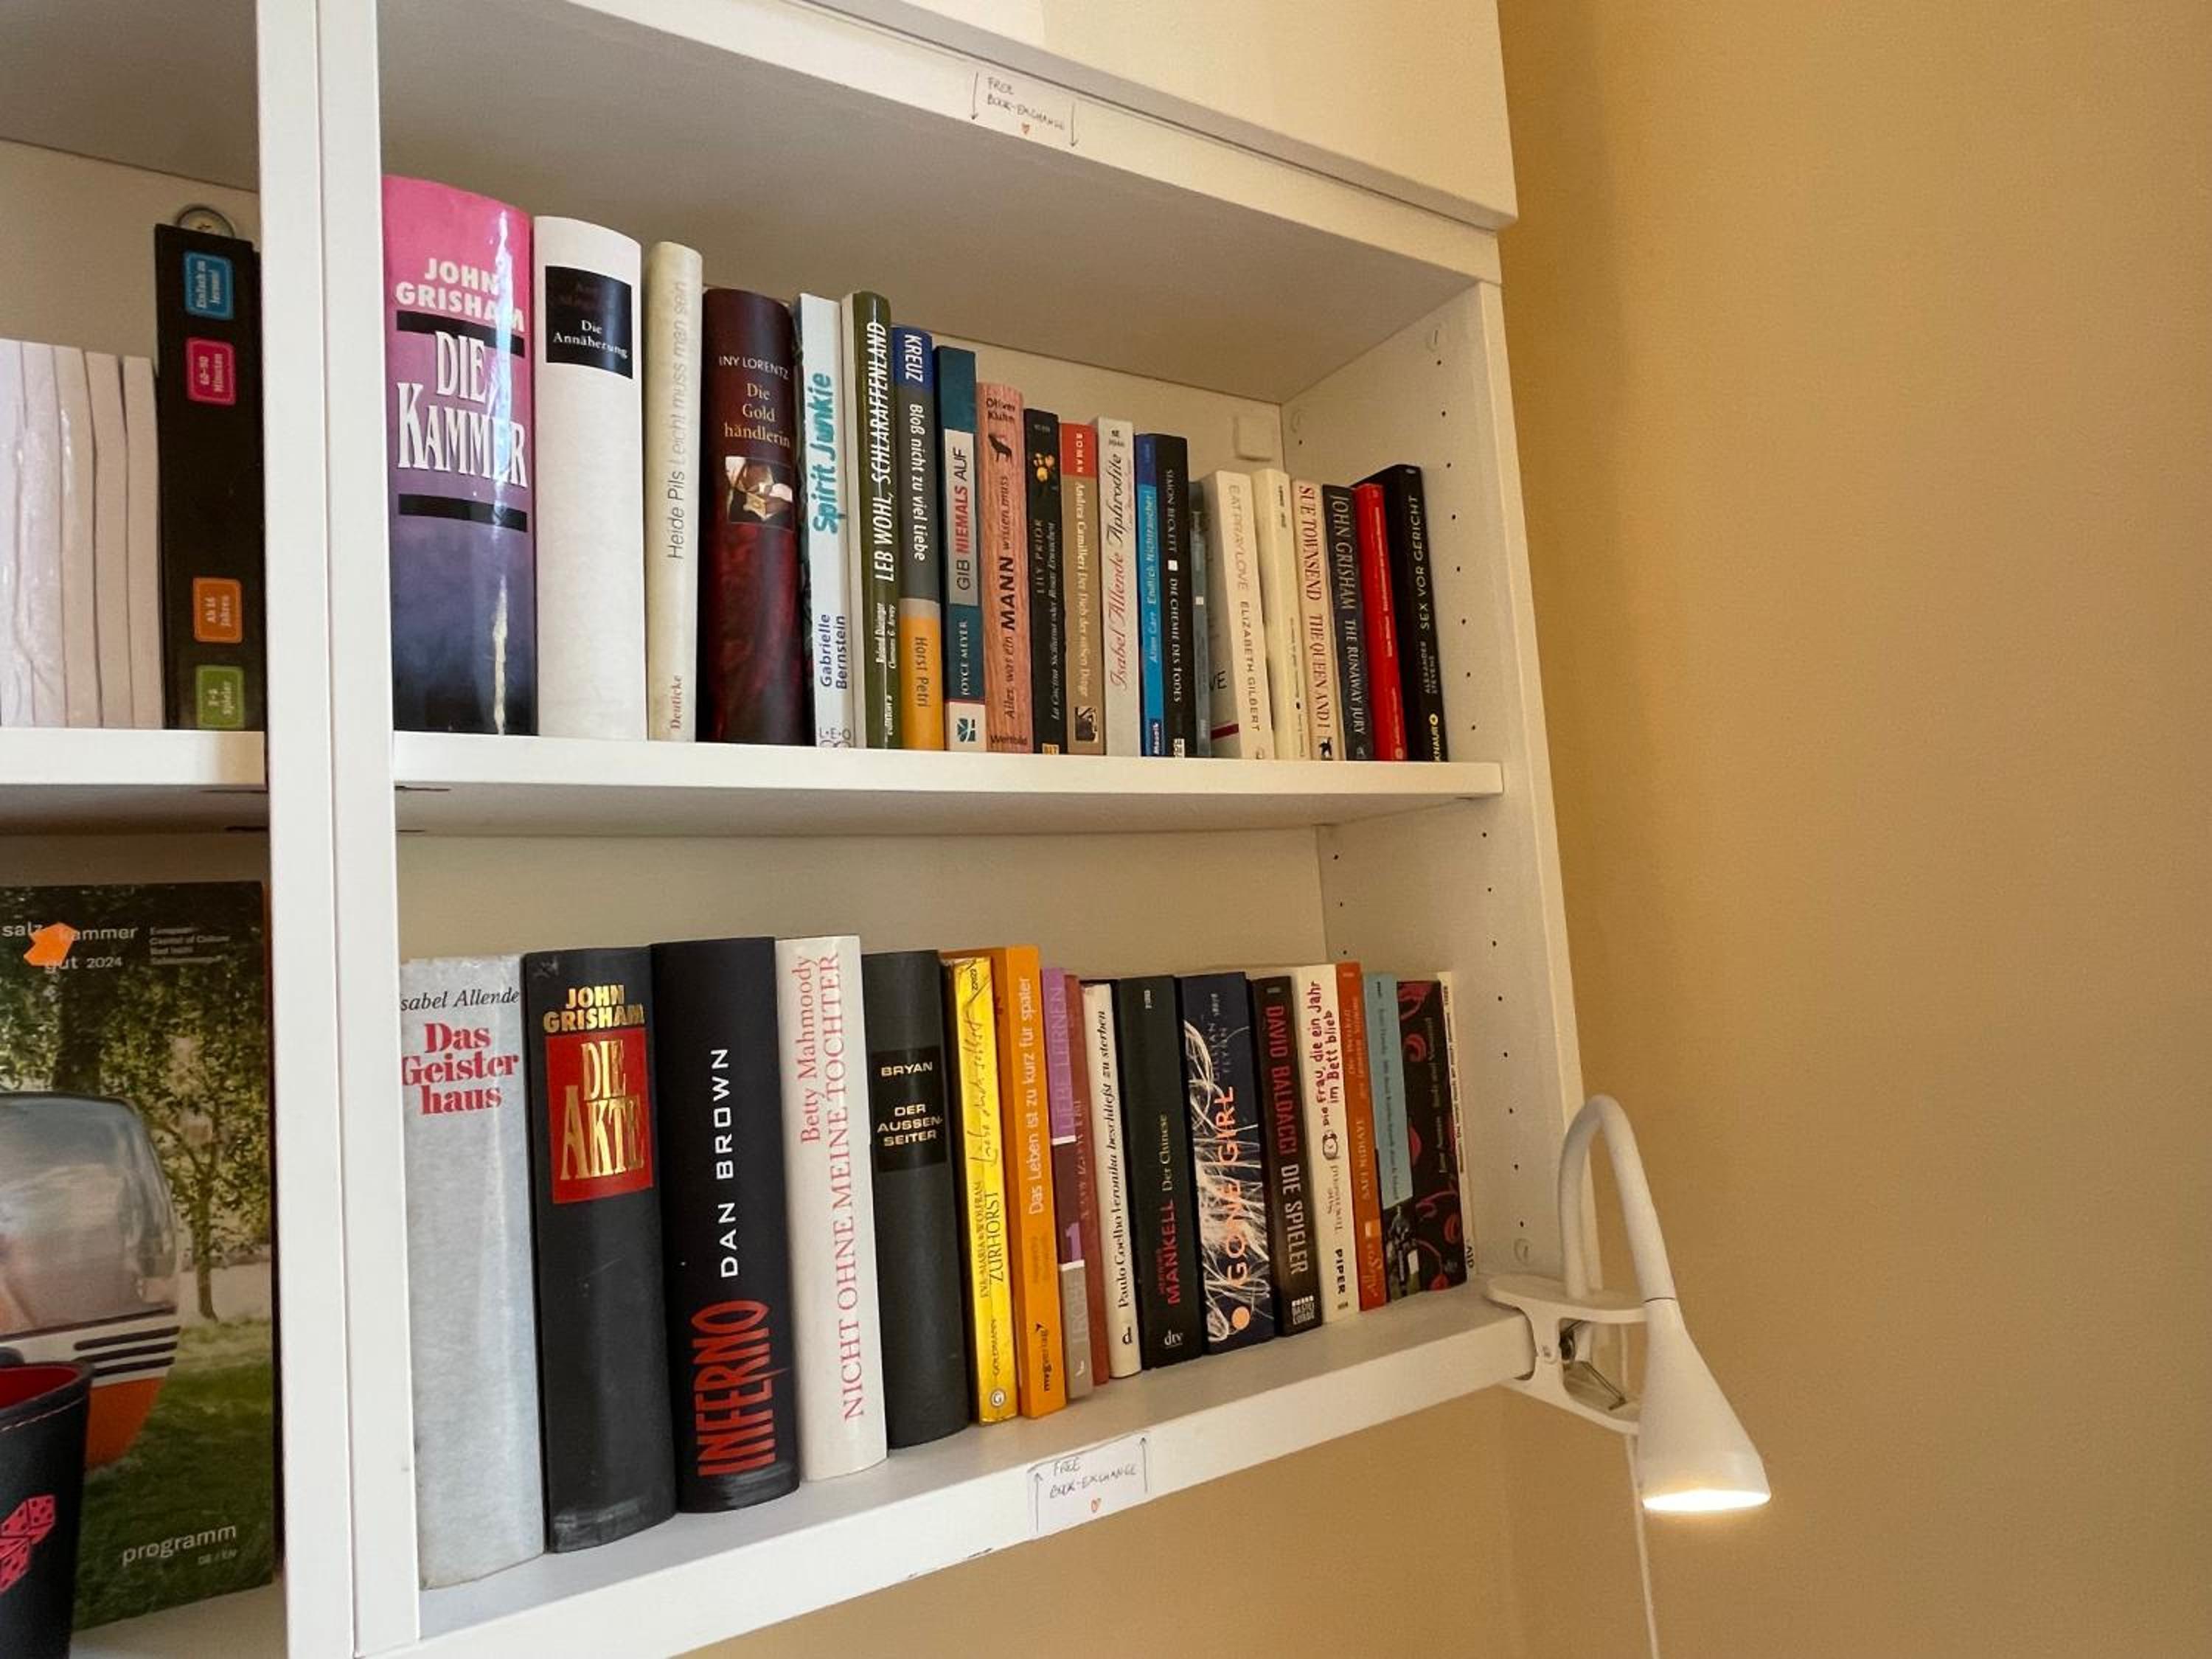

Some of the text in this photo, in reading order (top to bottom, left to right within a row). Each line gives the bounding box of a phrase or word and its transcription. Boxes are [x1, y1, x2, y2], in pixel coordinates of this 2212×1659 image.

[395, 282, 525, 332] GRISHAM
[424, 257, 500, 296] JOHN
[552, 332, 628, 360] Annäherung
[581, 319, 602, 334] Die
[904, 334, 925, 383] KREUZ
[435, 330, 487, 404] DIE
[669, 280, 687, 465] Leicht muss man sein
[719, 355, 789, 380] INY LORENTZ
[746, 383, 771, 400] Die
[397, 382, 529, 488] KAMMER
[723, 421, 791, 448] händlerin
[742, 403, 776, 422] Gold
[807, 372, 837, 462] Junkie
[866, 322, 892, 485] SCHLARAFFENLAND
[908, 403, 929, 561] Bloß nicht zu viel Liebe
[1075, 433, 1085, 473] ROMAN
[667, 470, 685, 559] Heide Pils
[952, 446, 971, 591] GIB NIEMALS AUF
[1075, 481, 1089, 569] Andrea Camilleri
[1105, 454, 1128, 546] Aphrodite
[1166, 469, 1178, 552] SIMON BECKETT
[874, 550, 895, 582] LEB
[1234, 552, 1250, 591] LOVE
[1298, 485, 1323, 601] SUE TOWNSEND
[1329, 495, 1357, 611] JOHN GRISHAM
[1408, 494, 1430, 630] SEX VOR GERICHT
[998, 557, 1016, 631] MANN
[1107, 552, 1125, 624] Allende
[818, 613, 832, 687] Gabrielle
[834, 615, 848, 690] Bernstein
[959, 619, 970, 696] JOYCE MEYER
[1108, 625, 1128, 689] Isabel
[1169, 577, 1183, 703] DIE CHEMIE DES TODES
[1309, 613, 1324, 641] THE
[914, 636, 931, 707] Horst Petri
[1239, 601, 1261, 732] ELIZABETH GILBERT
[1309, 641, 1328, 689] QUEEN
[1343, 619, 1366, 735] THE RUNAWAY JURY
[1315, 693, 1331, 721] AND
[1, 922, 138, 942] salzammer
[87, 956, 123, 970] 2024
[400, 987, 521, 1011] sabel Allende
[543, 1004, 645, 1033] GRISHAM
[566, 985, 626, 1009] JOHN
[1307, 981, 1323, 1014] Jahr
[1309, 1018, 1323, 1037] ein
[403, 1051, 520, 1086] Geister
[424, 1023, 493, 1053] Das
[581, 1040, 626, 1100] DIE
[791, 956, 825, 1144] Betty Mahmoody
[881, 1062, 933, 1077] BRYAN
[1310, 1042, 1324, 1062] die
[1324, 1010, 1340, 1104] im Bett blieb
[421, 1085, 502, 1115] haus
[894, 1104, 926, 1116] DER
[1015, 977, 1044, 1214] Das Leben ist zu kurz für später
[1315, 1065, 1326, 1103] Frau,
[560, 1085, 645, 1180] AKTE
[711, 1049, 738, 1279] DAN BROWN
[883, 1129, 936, 1147] SEITER
[1096, 1010, 1130, 1309] Paulo Coelho Veronika beschließt zu sterben
[1265, 1006, 1309, 1275] DAVID BALDACCI DIE SPIELER
[818, 953, 864, 1422] NICHT OHNE MEINE TOCHTER
[1157, 1113, 1181, 1305] MANKELL Der Chinese
[1213, 1086, 1248, 1286] GONE GIRL
[985, 1191, 1004, 1283] ZURHORST
[1335, 1249, 1346, 1295] PIPER
[990, 1318, 1001, 1377] GOLDMANN
[692, 1300, 790, 1478] INFERNO
[122, 1525, 236, 1567] programm
